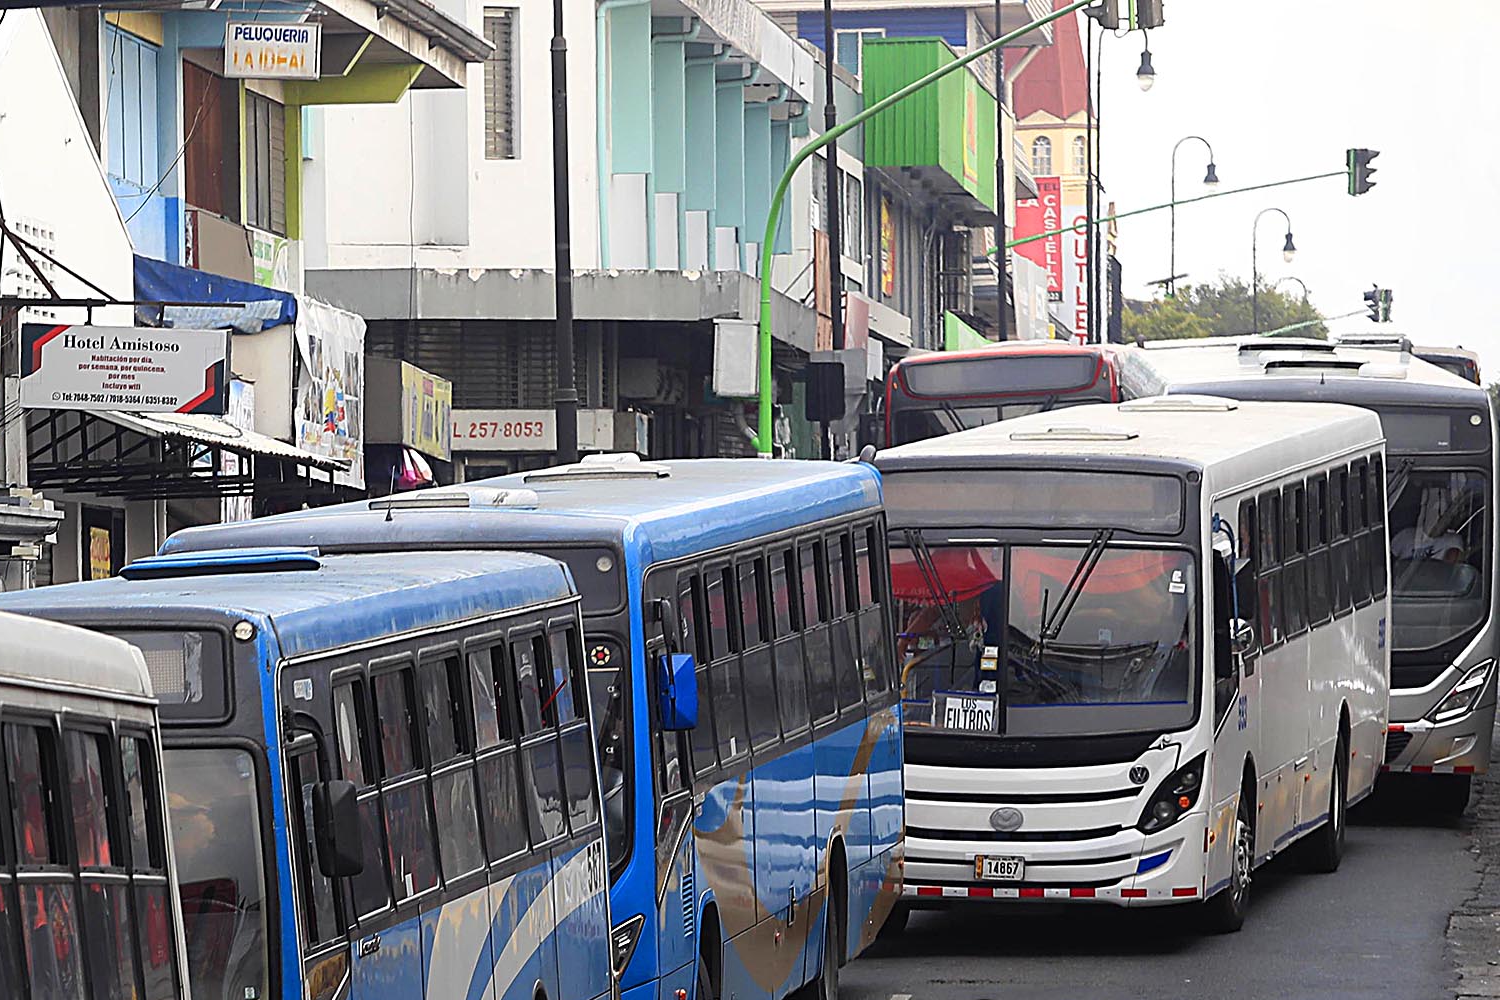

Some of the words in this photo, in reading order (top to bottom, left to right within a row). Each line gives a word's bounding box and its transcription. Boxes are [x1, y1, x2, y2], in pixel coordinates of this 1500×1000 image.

[234, 26, 309, 43] PELUQUERIA
[63, 334, 105, 349] Hotel
[109, 335, 180, 353] Amistoso
[128, 356, 141, 364] por
[78, 363, 90, 371] por
[120, 365, 132, 373] por
[961, 698, 977, 709] LOS
[946, 708, 991, 731] FILTROS
[987, 861, 1019, 875] 14867
